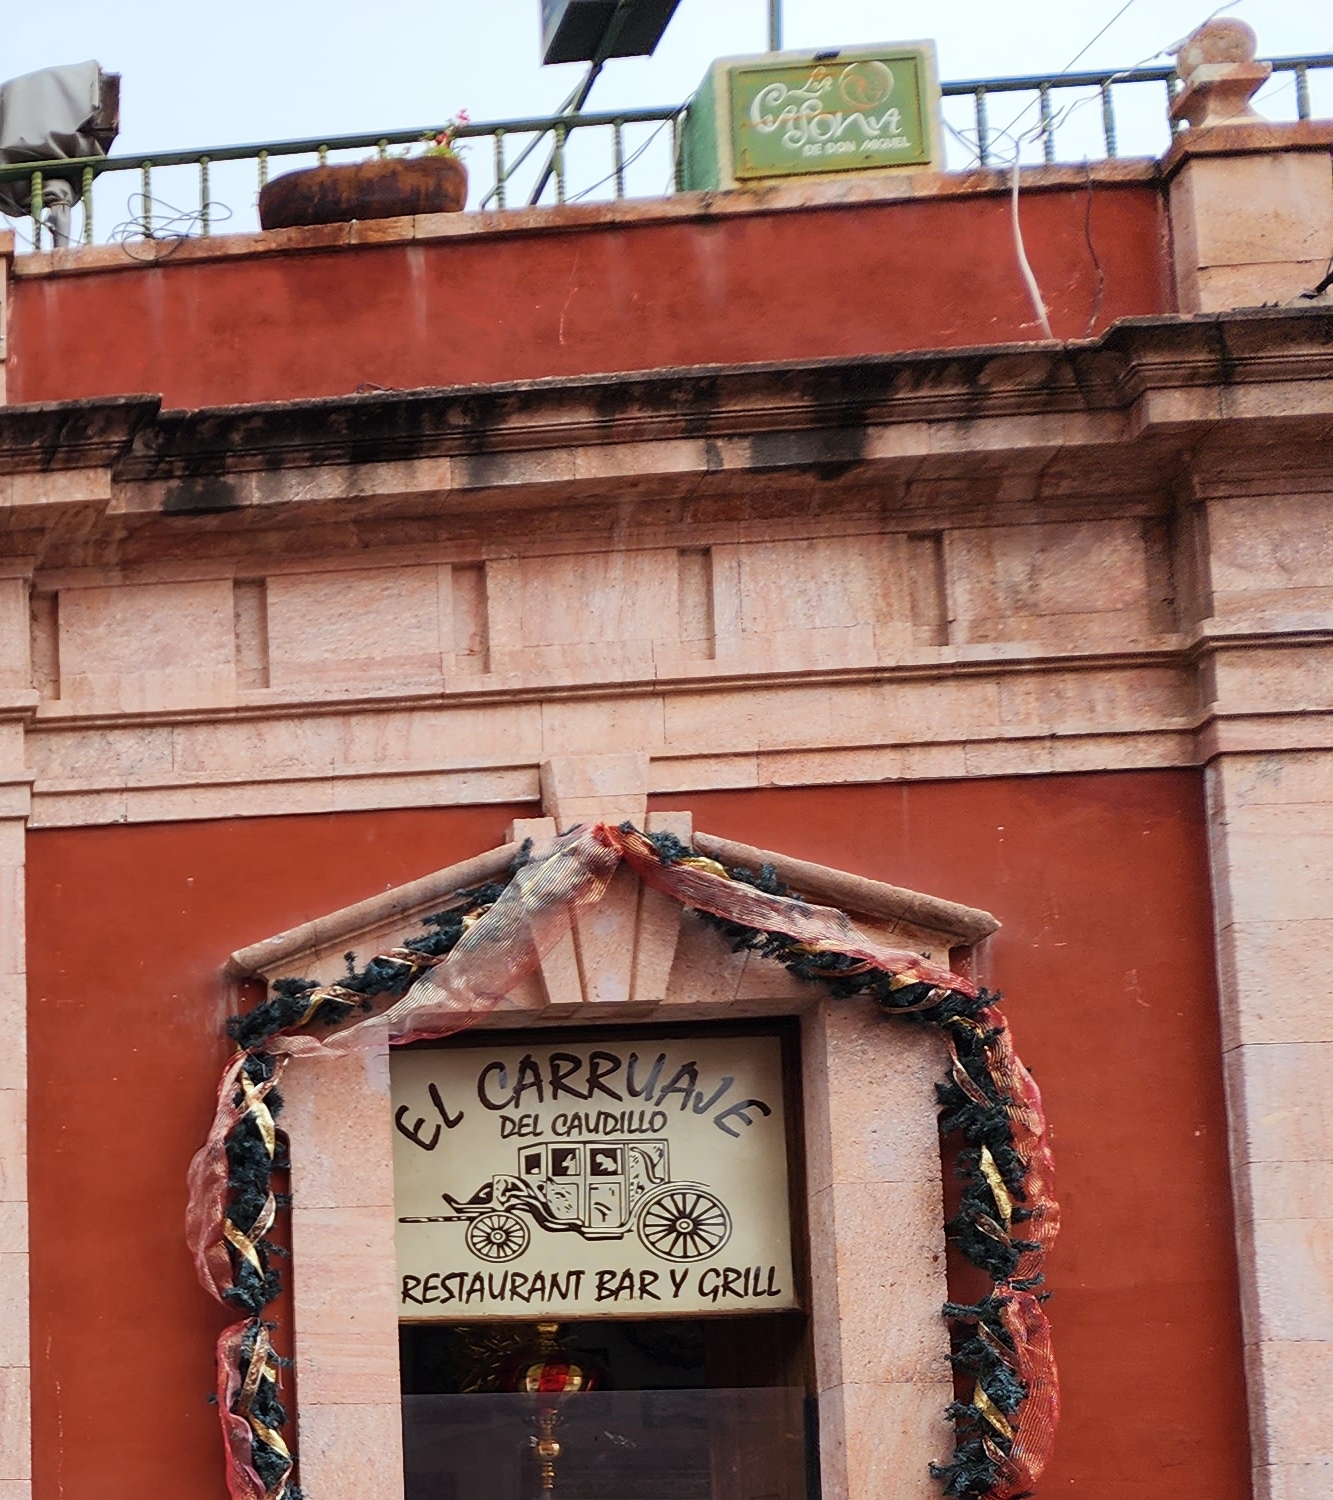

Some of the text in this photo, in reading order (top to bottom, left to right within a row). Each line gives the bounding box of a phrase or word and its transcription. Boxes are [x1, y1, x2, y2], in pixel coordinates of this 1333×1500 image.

[802, 136, 912, 157] DE DON MIGUEL
[395, 1051, 771, 1151] EL CARRUAJE
[500, 1110, 668, 1139] DEL CAUDILLO
[401, 1266, 782, 1304] RESTAURANT BAR Y GRILL
